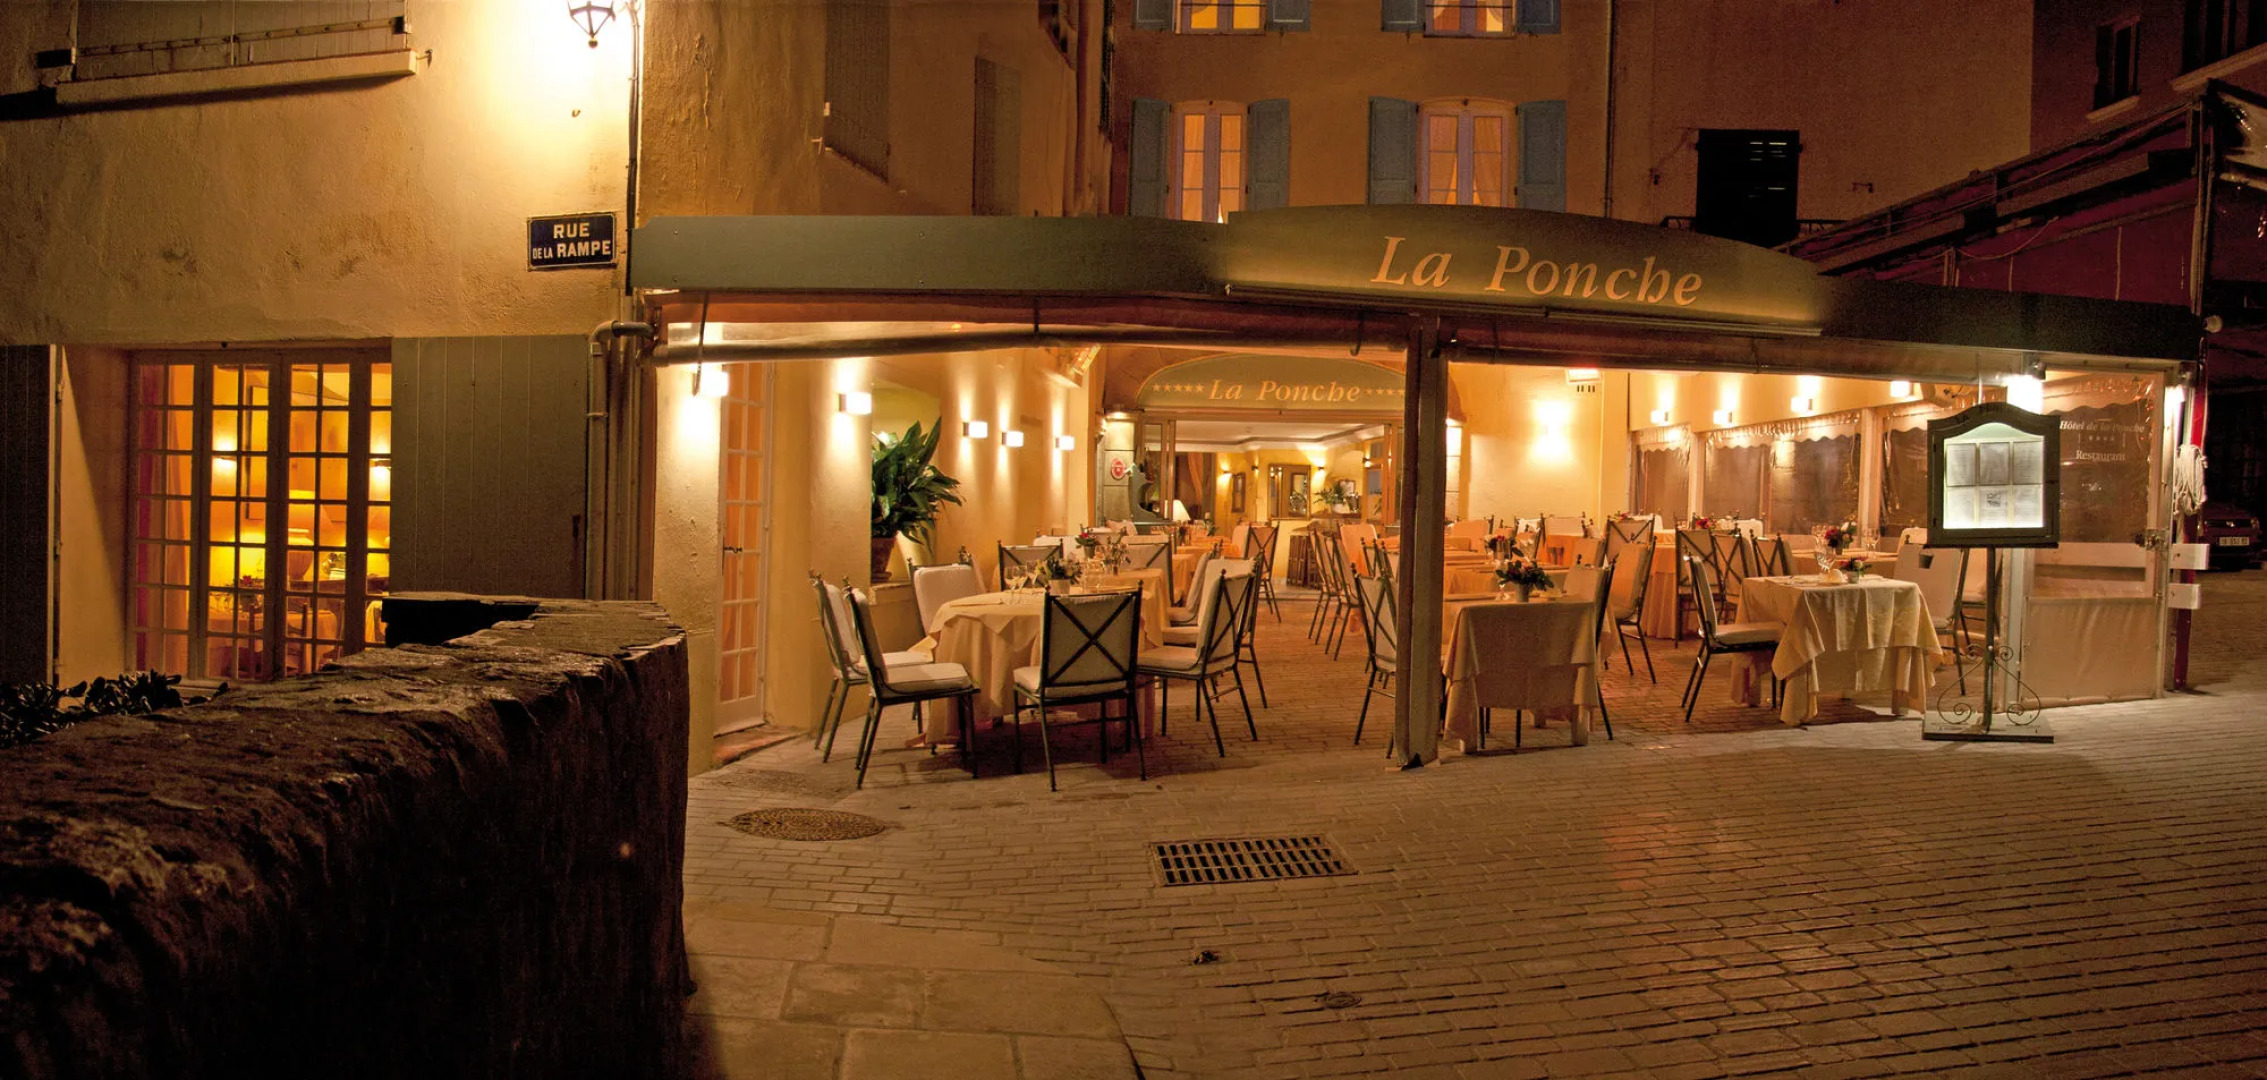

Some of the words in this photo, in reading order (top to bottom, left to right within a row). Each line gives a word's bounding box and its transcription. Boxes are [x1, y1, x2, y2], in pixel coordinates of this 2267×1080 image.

[553, 223, 590, 239] RUE
[532, 247, 542, 259] DE
[543, 247, 553, 259] LA
[557, 240, 611, 258] RAMPE
[1370, 236, 1452, 288] La
[1484, 245, 1702, 306] Ponche
[1208, 379, 1243, 401] La
[1257, 380, 1361, 402] Ponche
[2059, 420, 2084, 431] Hôtel
[2076, 450, 2126, 462] Restaurant
